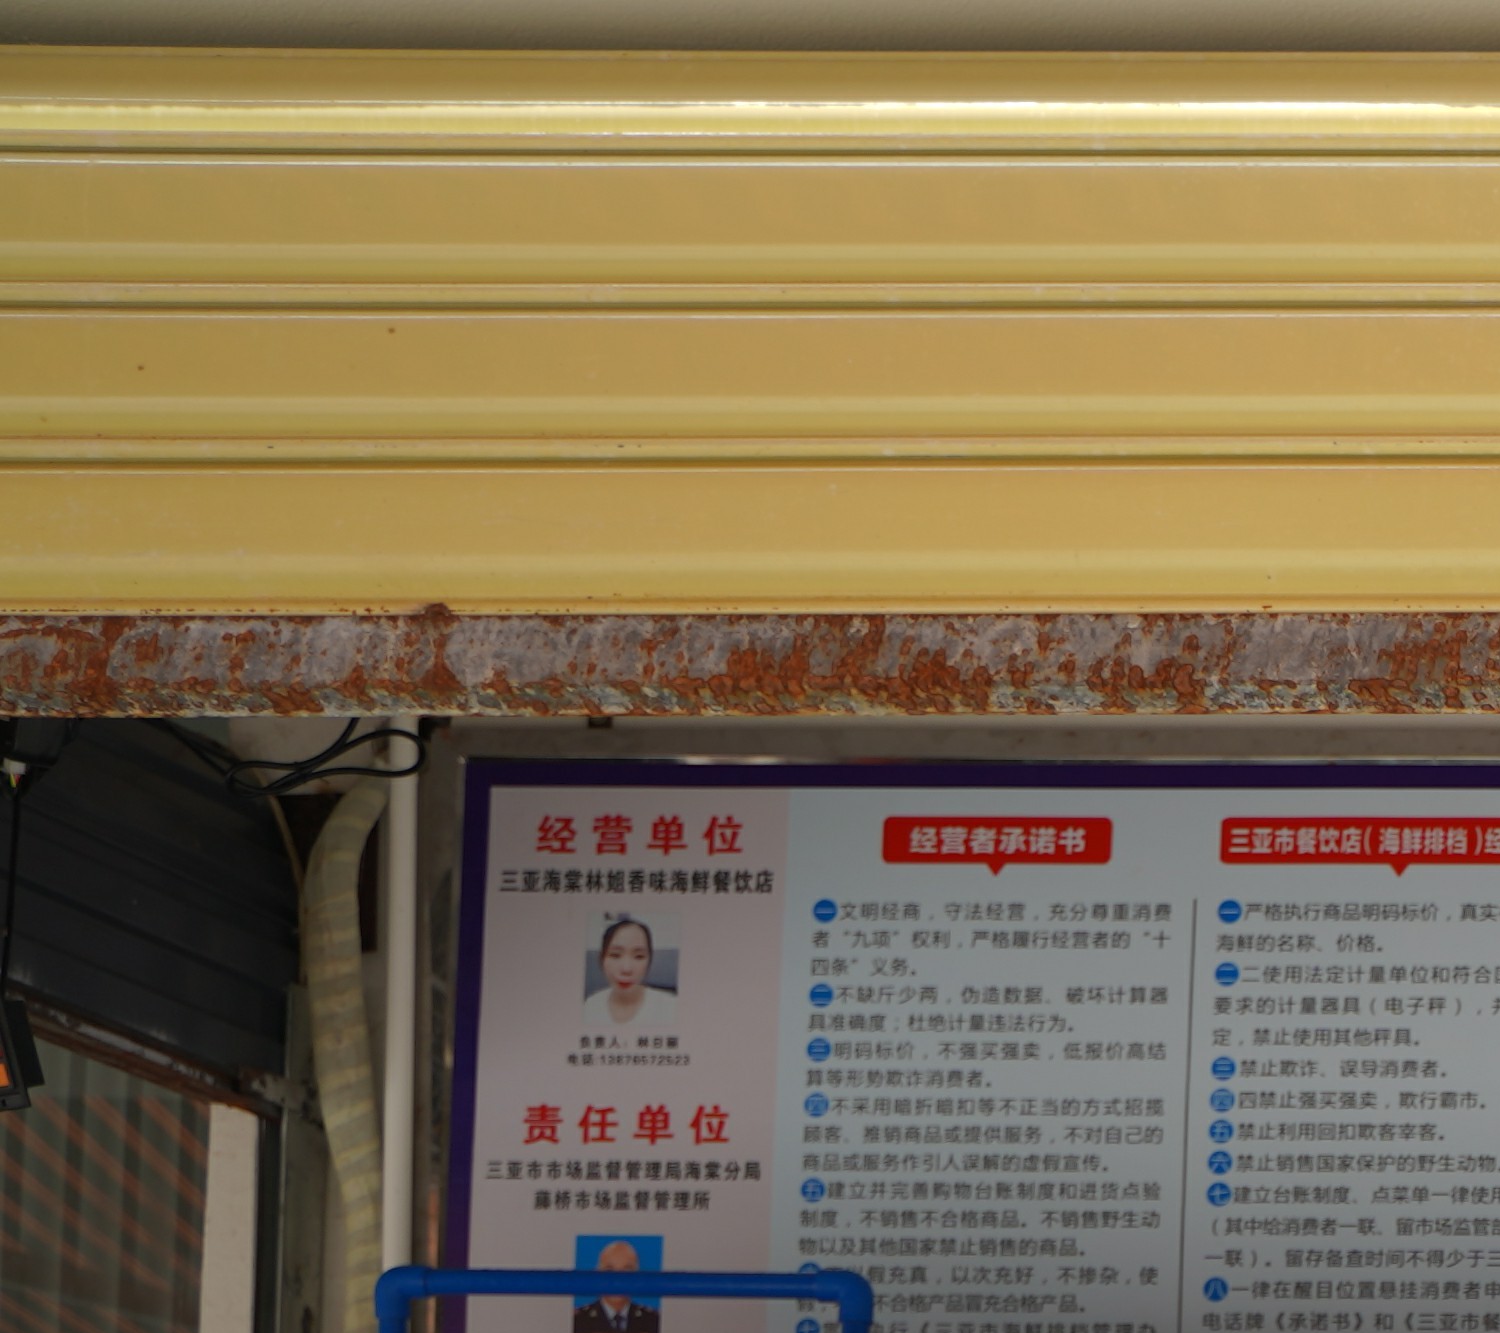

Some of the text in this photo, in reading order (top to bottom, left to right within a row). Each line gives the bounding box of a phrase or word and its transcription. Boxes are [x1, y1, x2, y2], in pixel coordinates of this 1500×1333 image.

[537, 814, 745, 856] 经营单位
[909, 828, 1086, 856] 经营者承诺书
[499, 869, 775, 895] 三亚海棠林姐香味海鲜餐饮店
[523, 1104, 732, 1146] 责任单位
[485, 1161, 762, 1181] 三亚市市场监督管理局海棠分局
[534, 1189, 712, 1212] 藤桥市场监督管理所
